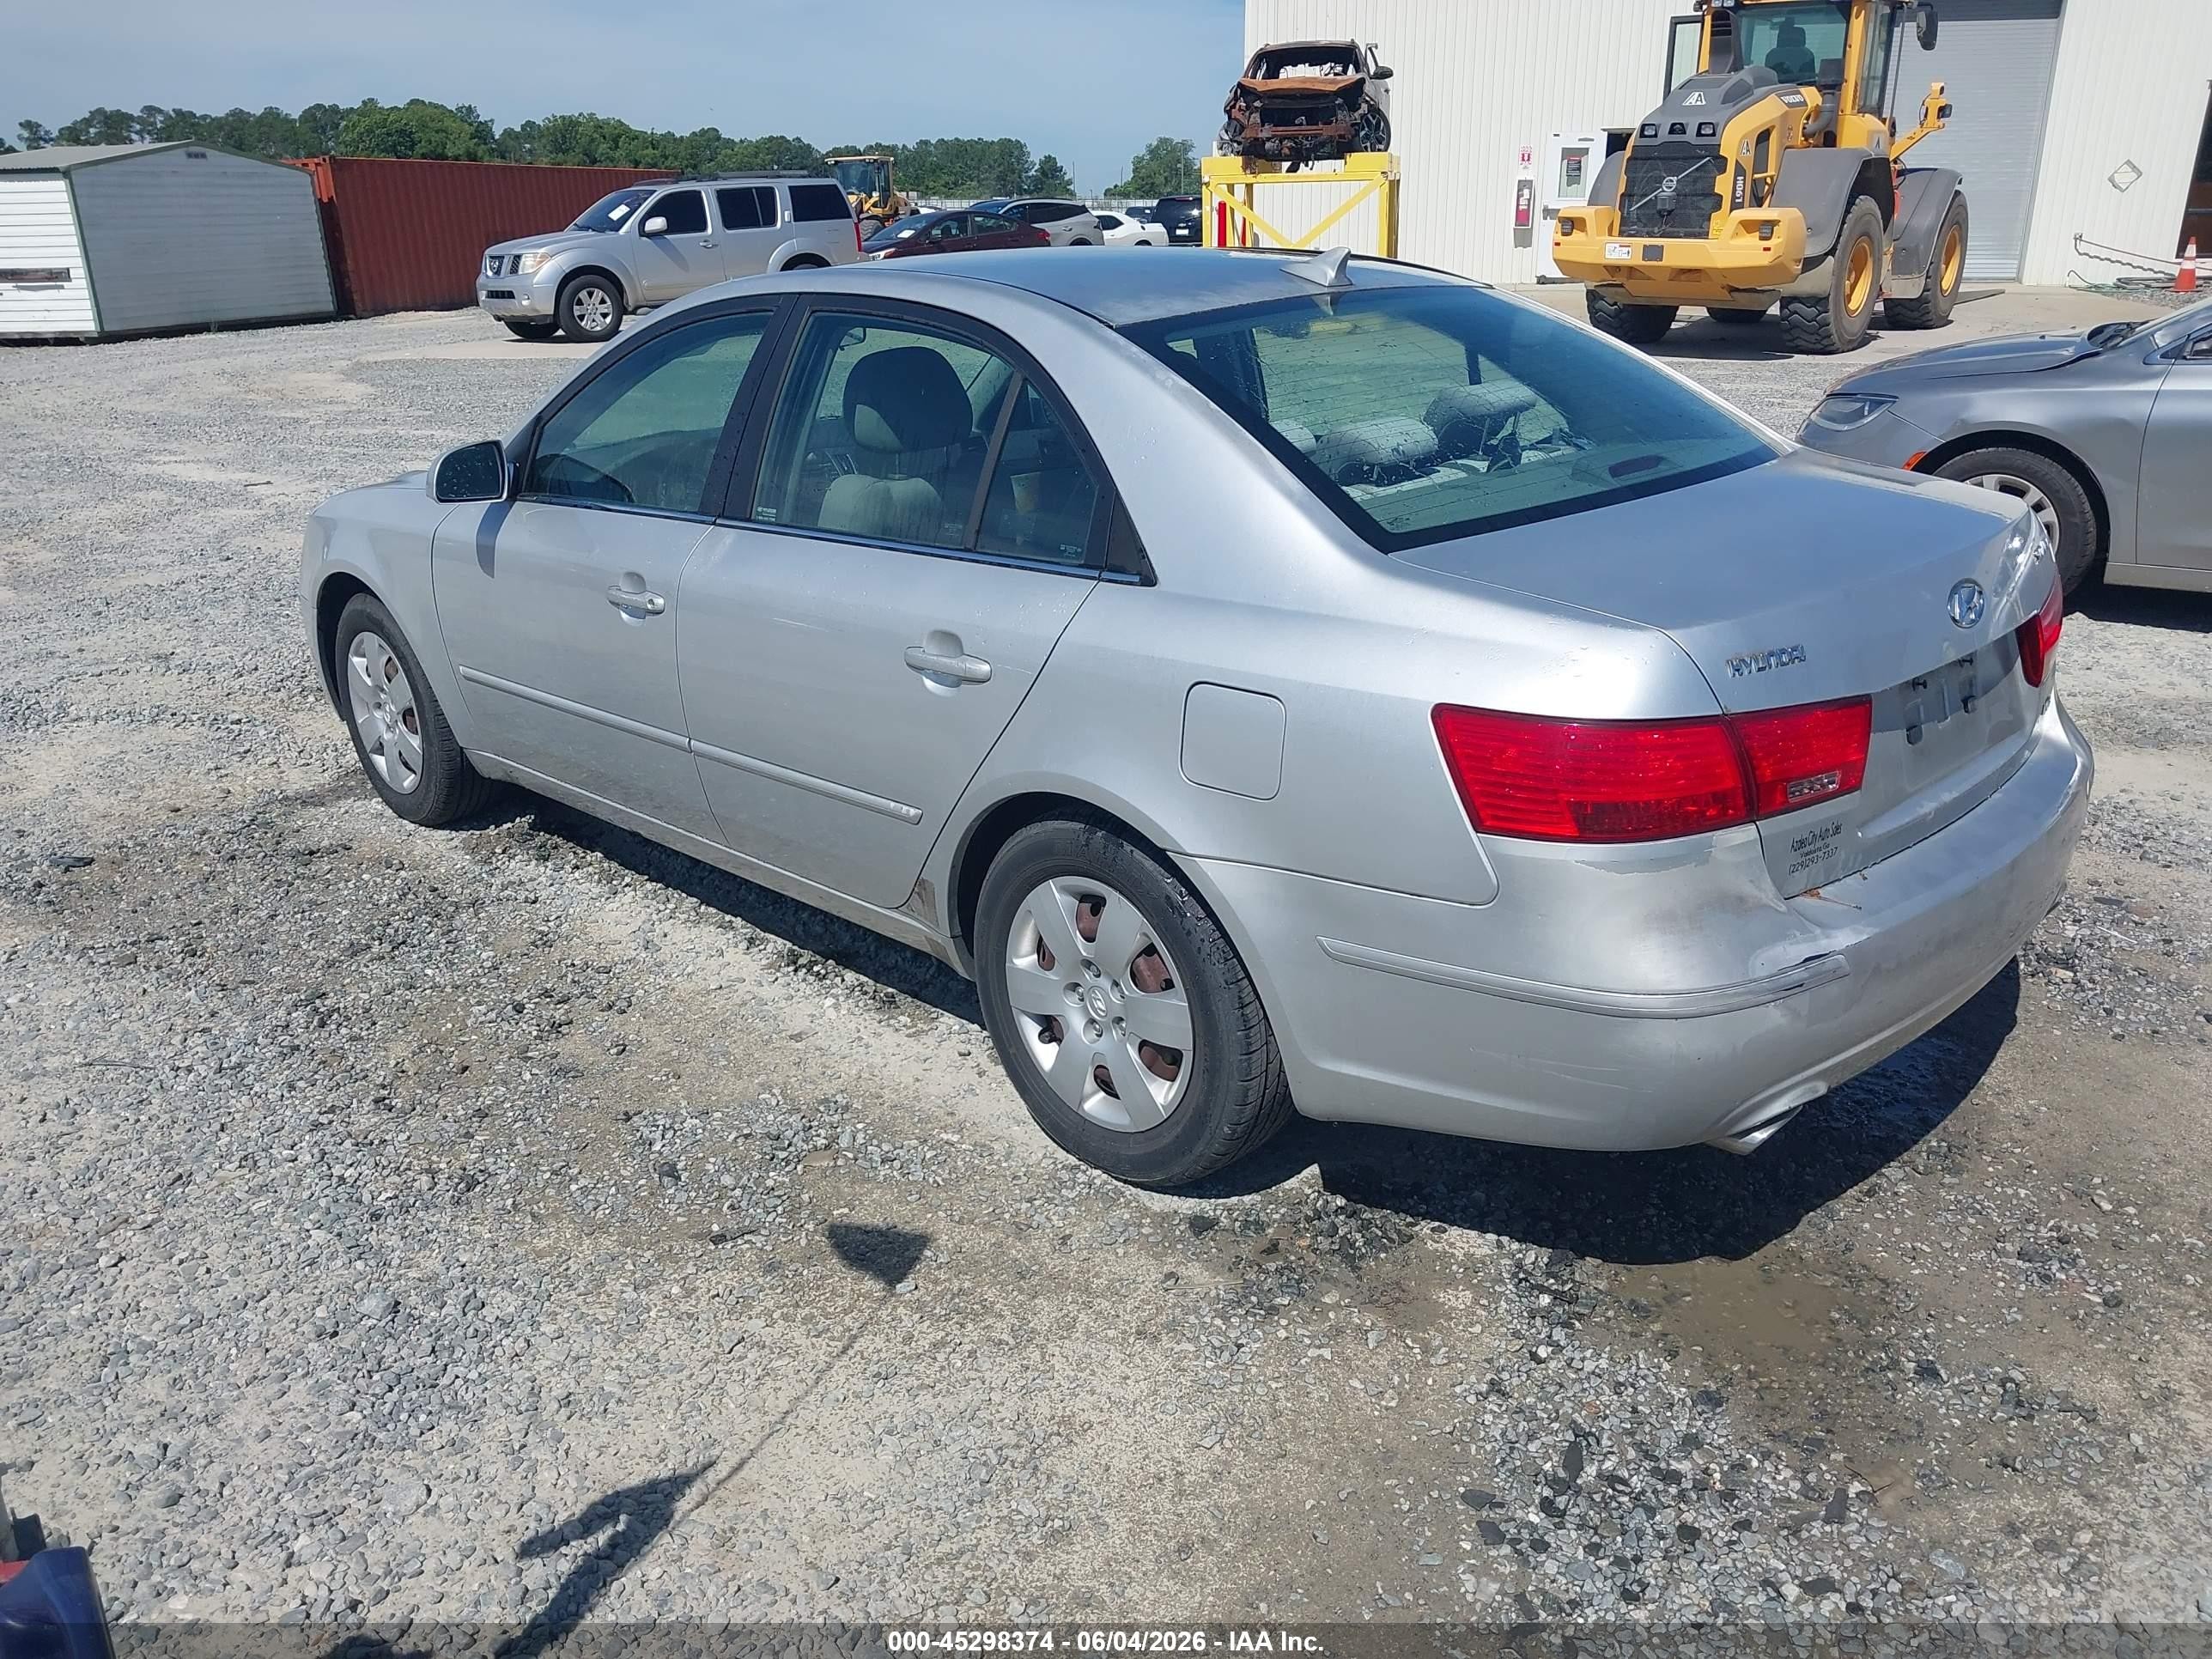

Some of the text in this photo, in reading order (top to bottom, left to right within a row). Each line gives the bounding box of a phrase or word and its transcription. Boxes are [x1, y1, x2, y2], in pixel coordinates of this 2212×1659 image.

[1780, 94, 1804, 104] VOLVO
[1735, 176, 1744, 203] L90H
[1725, 643, 1807, 678] HYUNDAI
[1808, 830, 1818, 848] City
[1818, 827, 1832, 842] Auto
[1831, 820, 1843, 837] Sales
[1822, 842, 1830, 850] Ga
[1788, 846, 1838, 876] (229)293-7337
